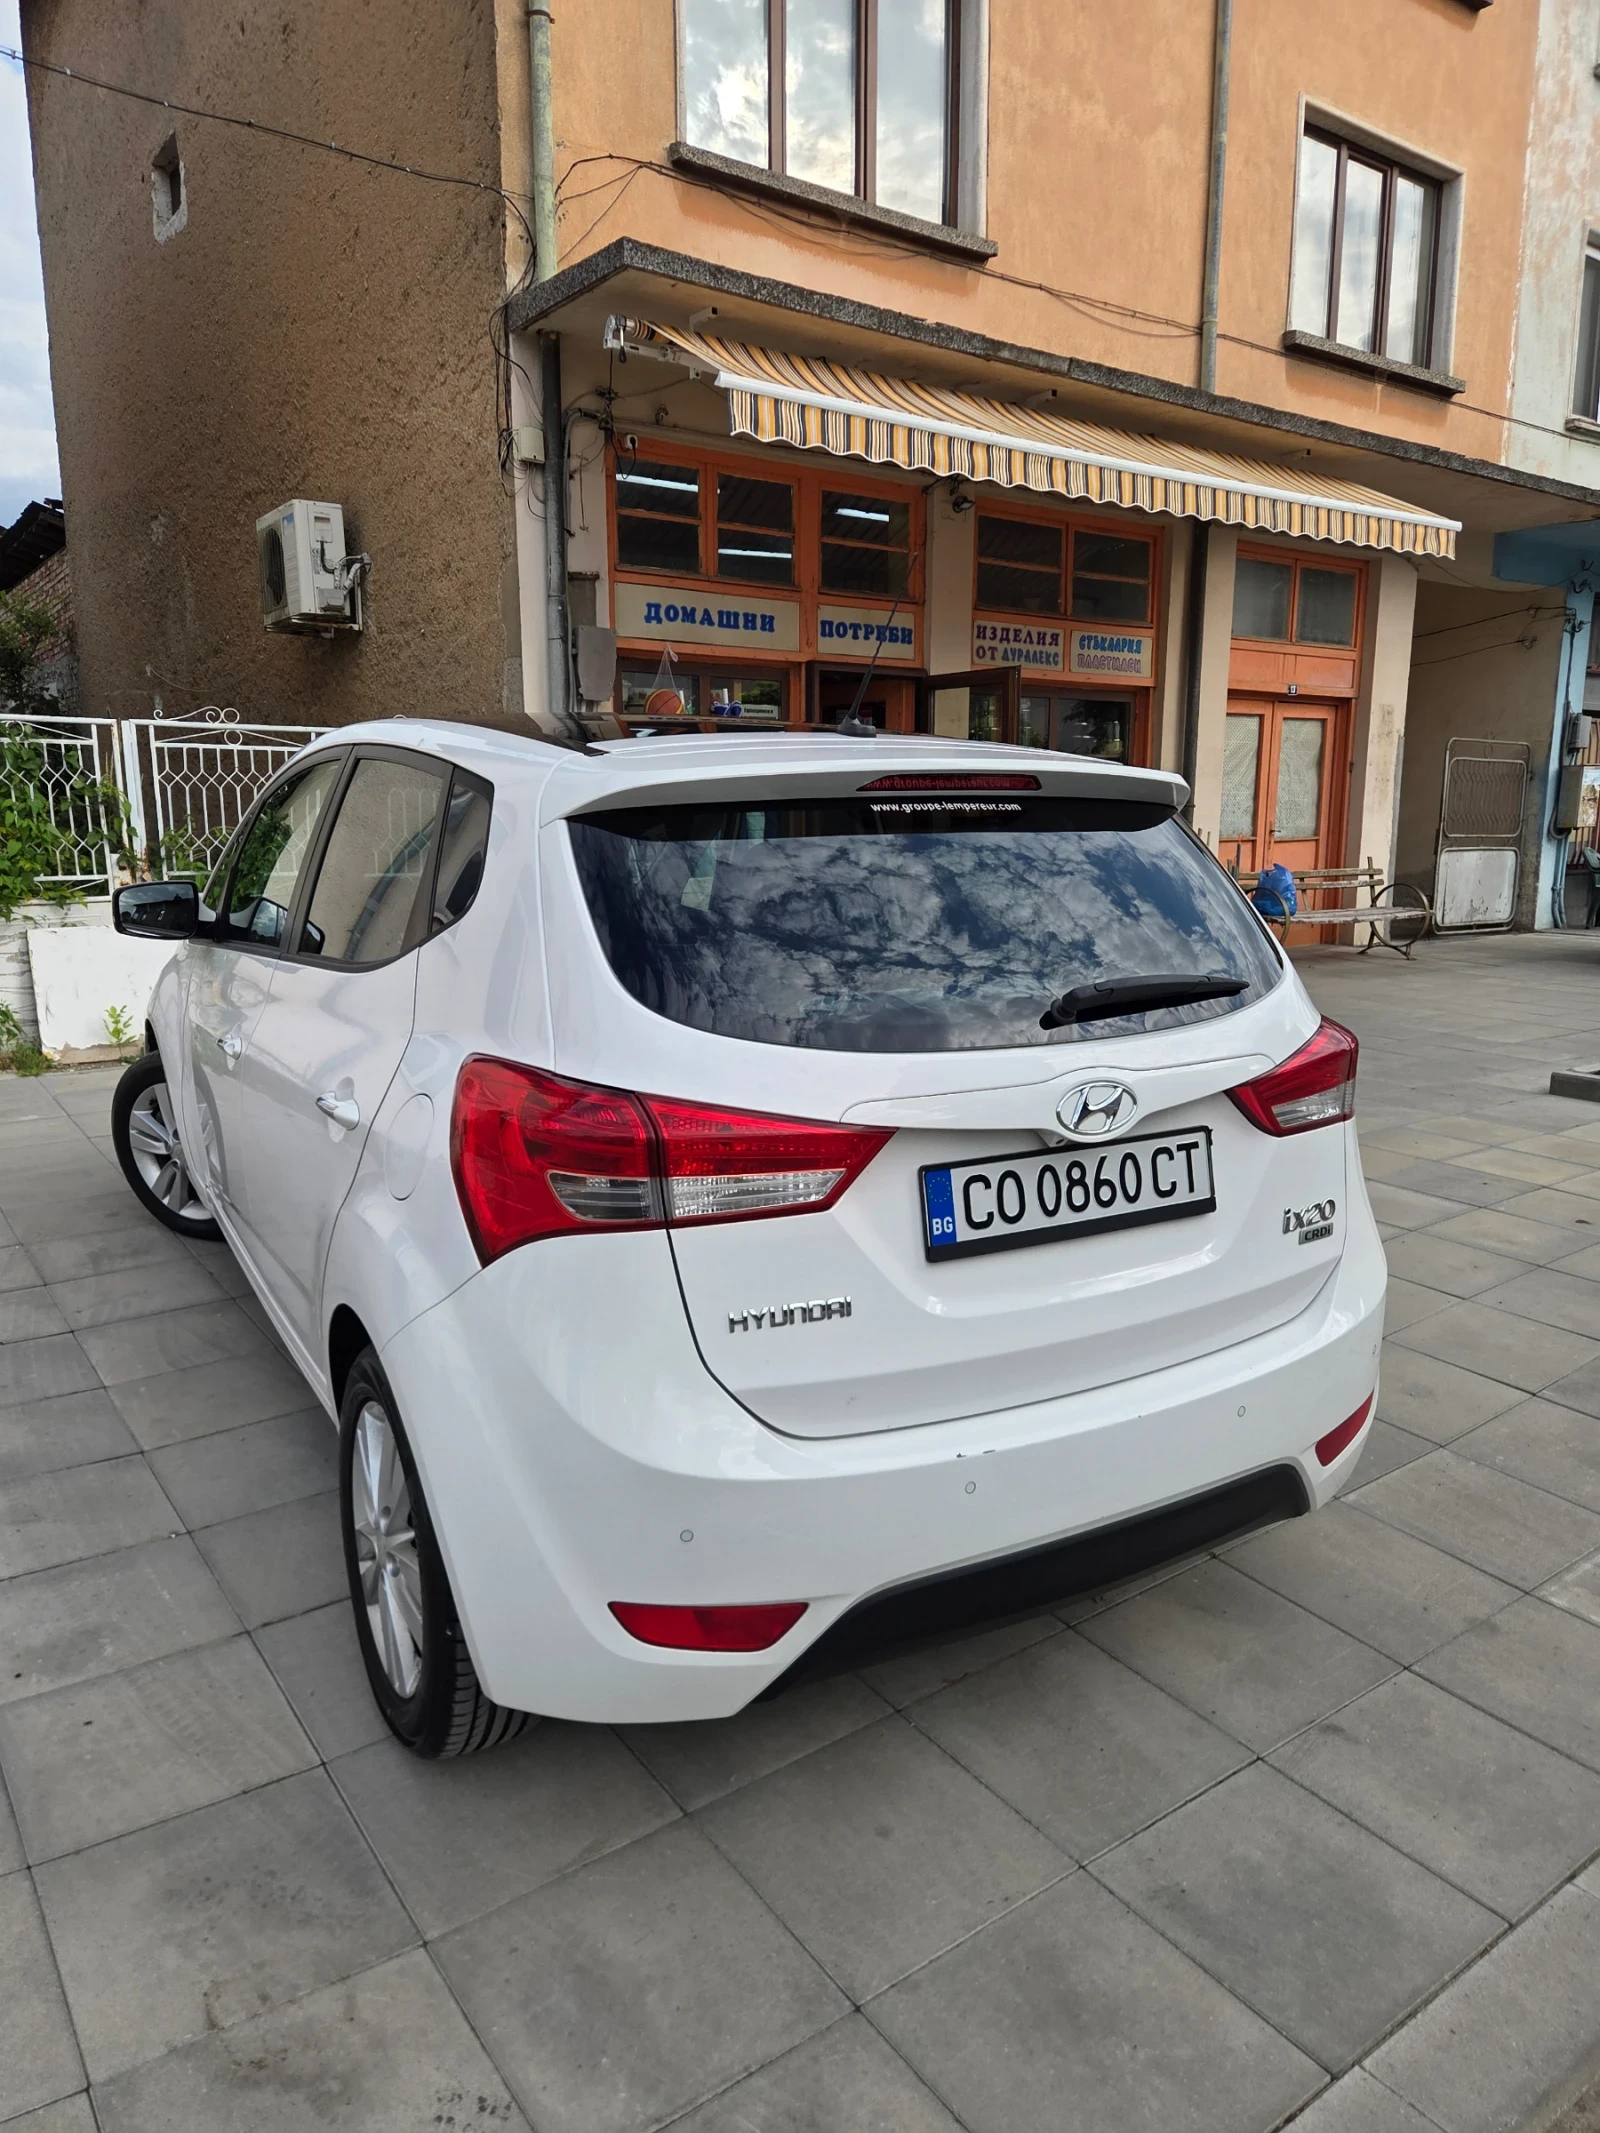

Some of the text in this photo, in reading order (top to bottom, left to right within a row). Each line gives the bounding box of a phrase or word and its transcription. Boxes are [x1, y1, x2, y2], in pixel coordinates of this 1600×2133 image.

[644, 602, 914, 645] ДОМАШНИ ПОТРЕБИ
[975, 624, 1060, 647] ИЗДЕЛИЯ
[1078, 634, 1143, 655] СТЪКЛАРИЯ
[975, 645, 1060, 667] ОТ ДУРАЛЕКС
[1077, 653, 1142, 674] ПЛАСТМАСИ
[870, 801, 1022, 813] www.groupe-lempereur.com
[932, 1140, 1200, 1236] BG CO 0860 CT
[1282, 1198, 1336, 1235] ix20
[1304, 1225, 1331, 1241] CRDi
[728, 1295, 852, 1334] HYUNDAI
